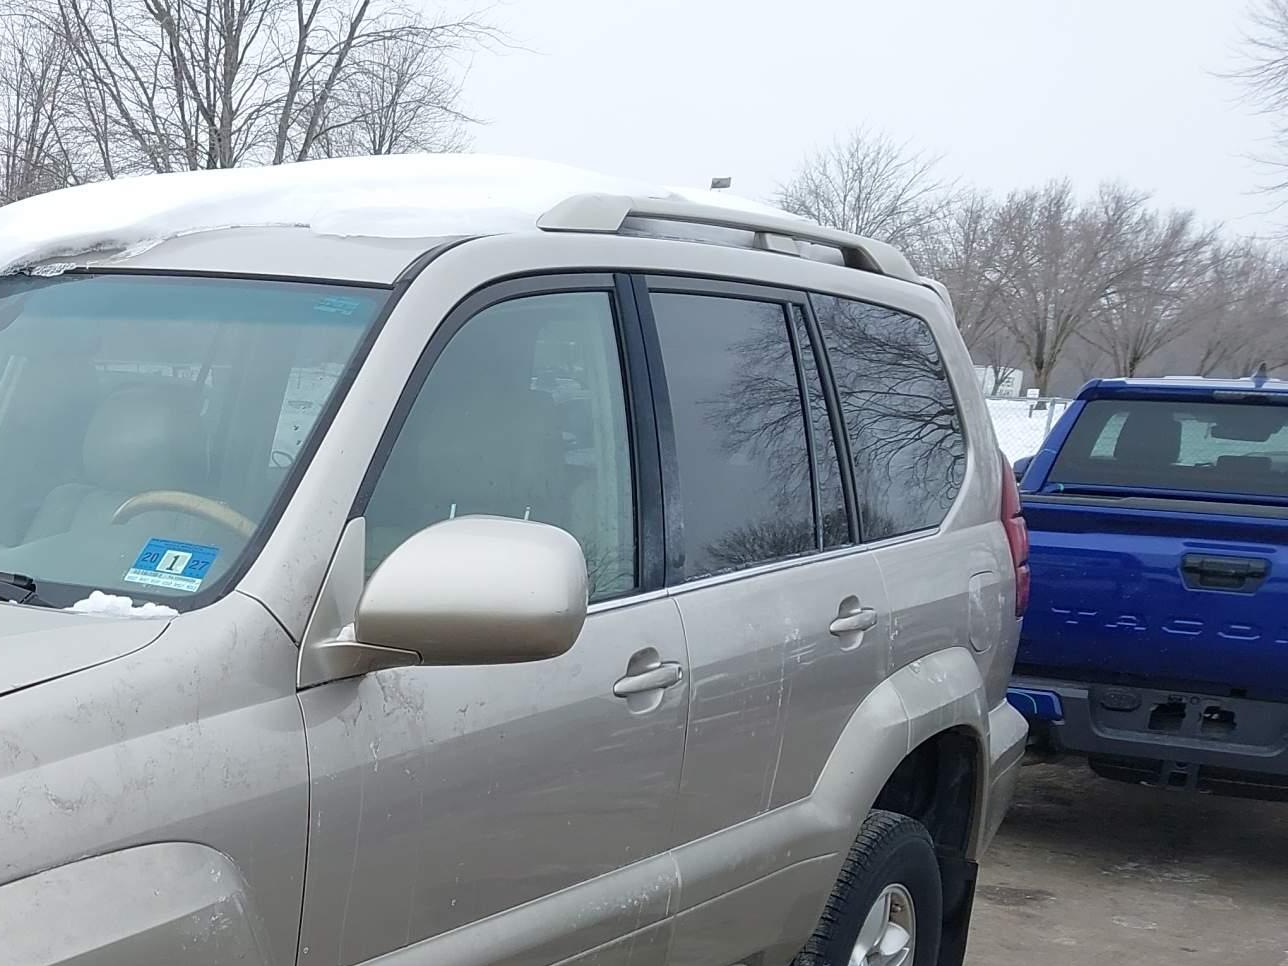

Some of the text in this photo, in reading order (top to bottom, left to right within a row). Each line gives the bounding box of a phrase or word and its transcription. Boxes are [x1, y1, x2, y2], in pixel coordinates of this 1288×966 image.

[142, 552, 210, 571] 20 1 27
[1051, 607, 1288, 644] TACO
